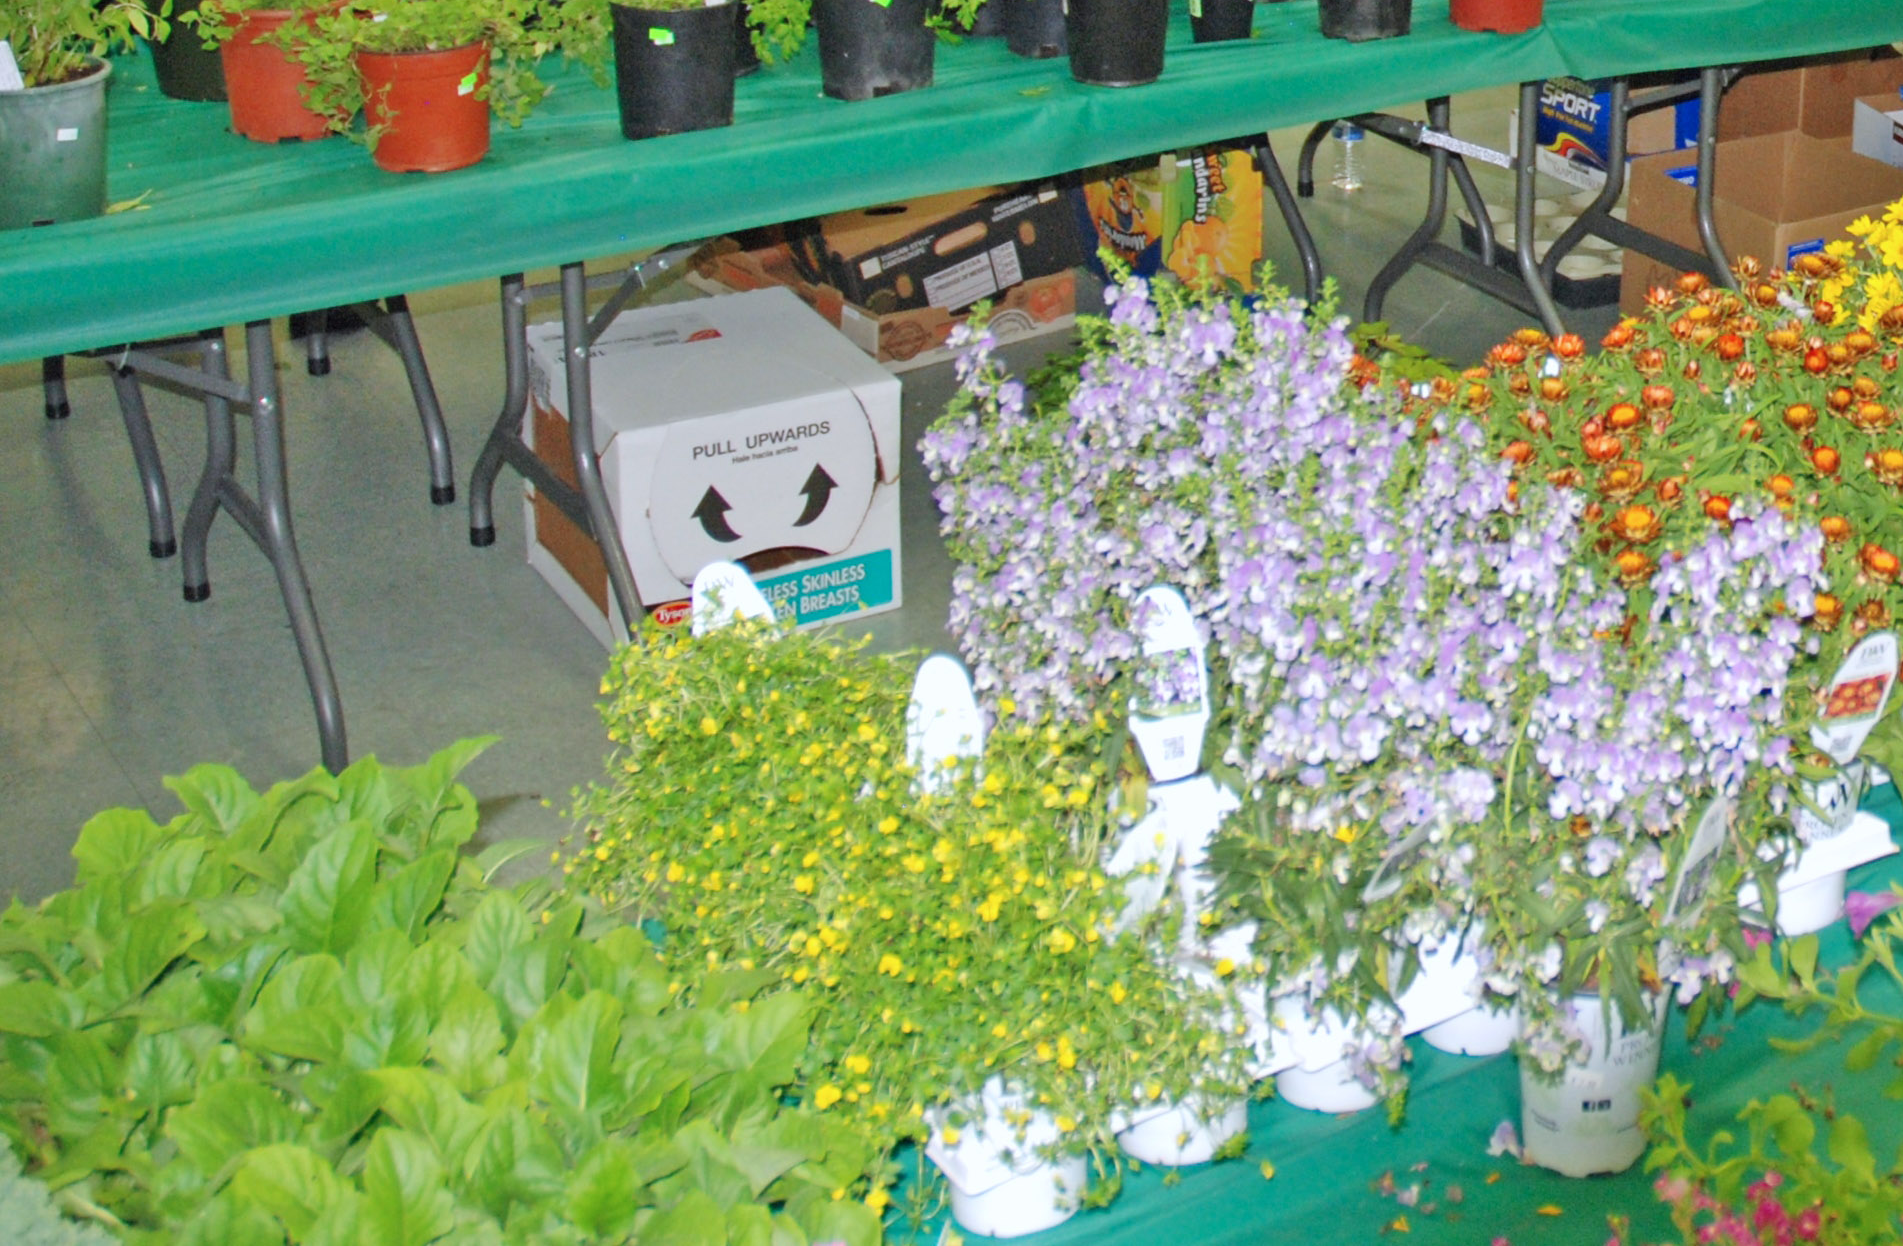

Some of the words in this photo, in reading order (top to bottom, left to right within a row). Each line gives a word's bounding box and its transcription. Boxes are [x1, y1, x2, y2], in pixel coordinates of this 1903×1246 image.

[1540, 82, 1602, 124] SPORT
[1193, 156, 1212, 224] ndarins
[692, 439, 736, 461] PULL
[745, 420, 831, 450] UPWARDS
[732, 454, 750, 465] Hale
[751, 449, 774, 461] hacia
[775, 445, 798, 456] arriba
[801, 563, 866, 593] SKINLESS
[800, 584, 860, 614] BREASTS
